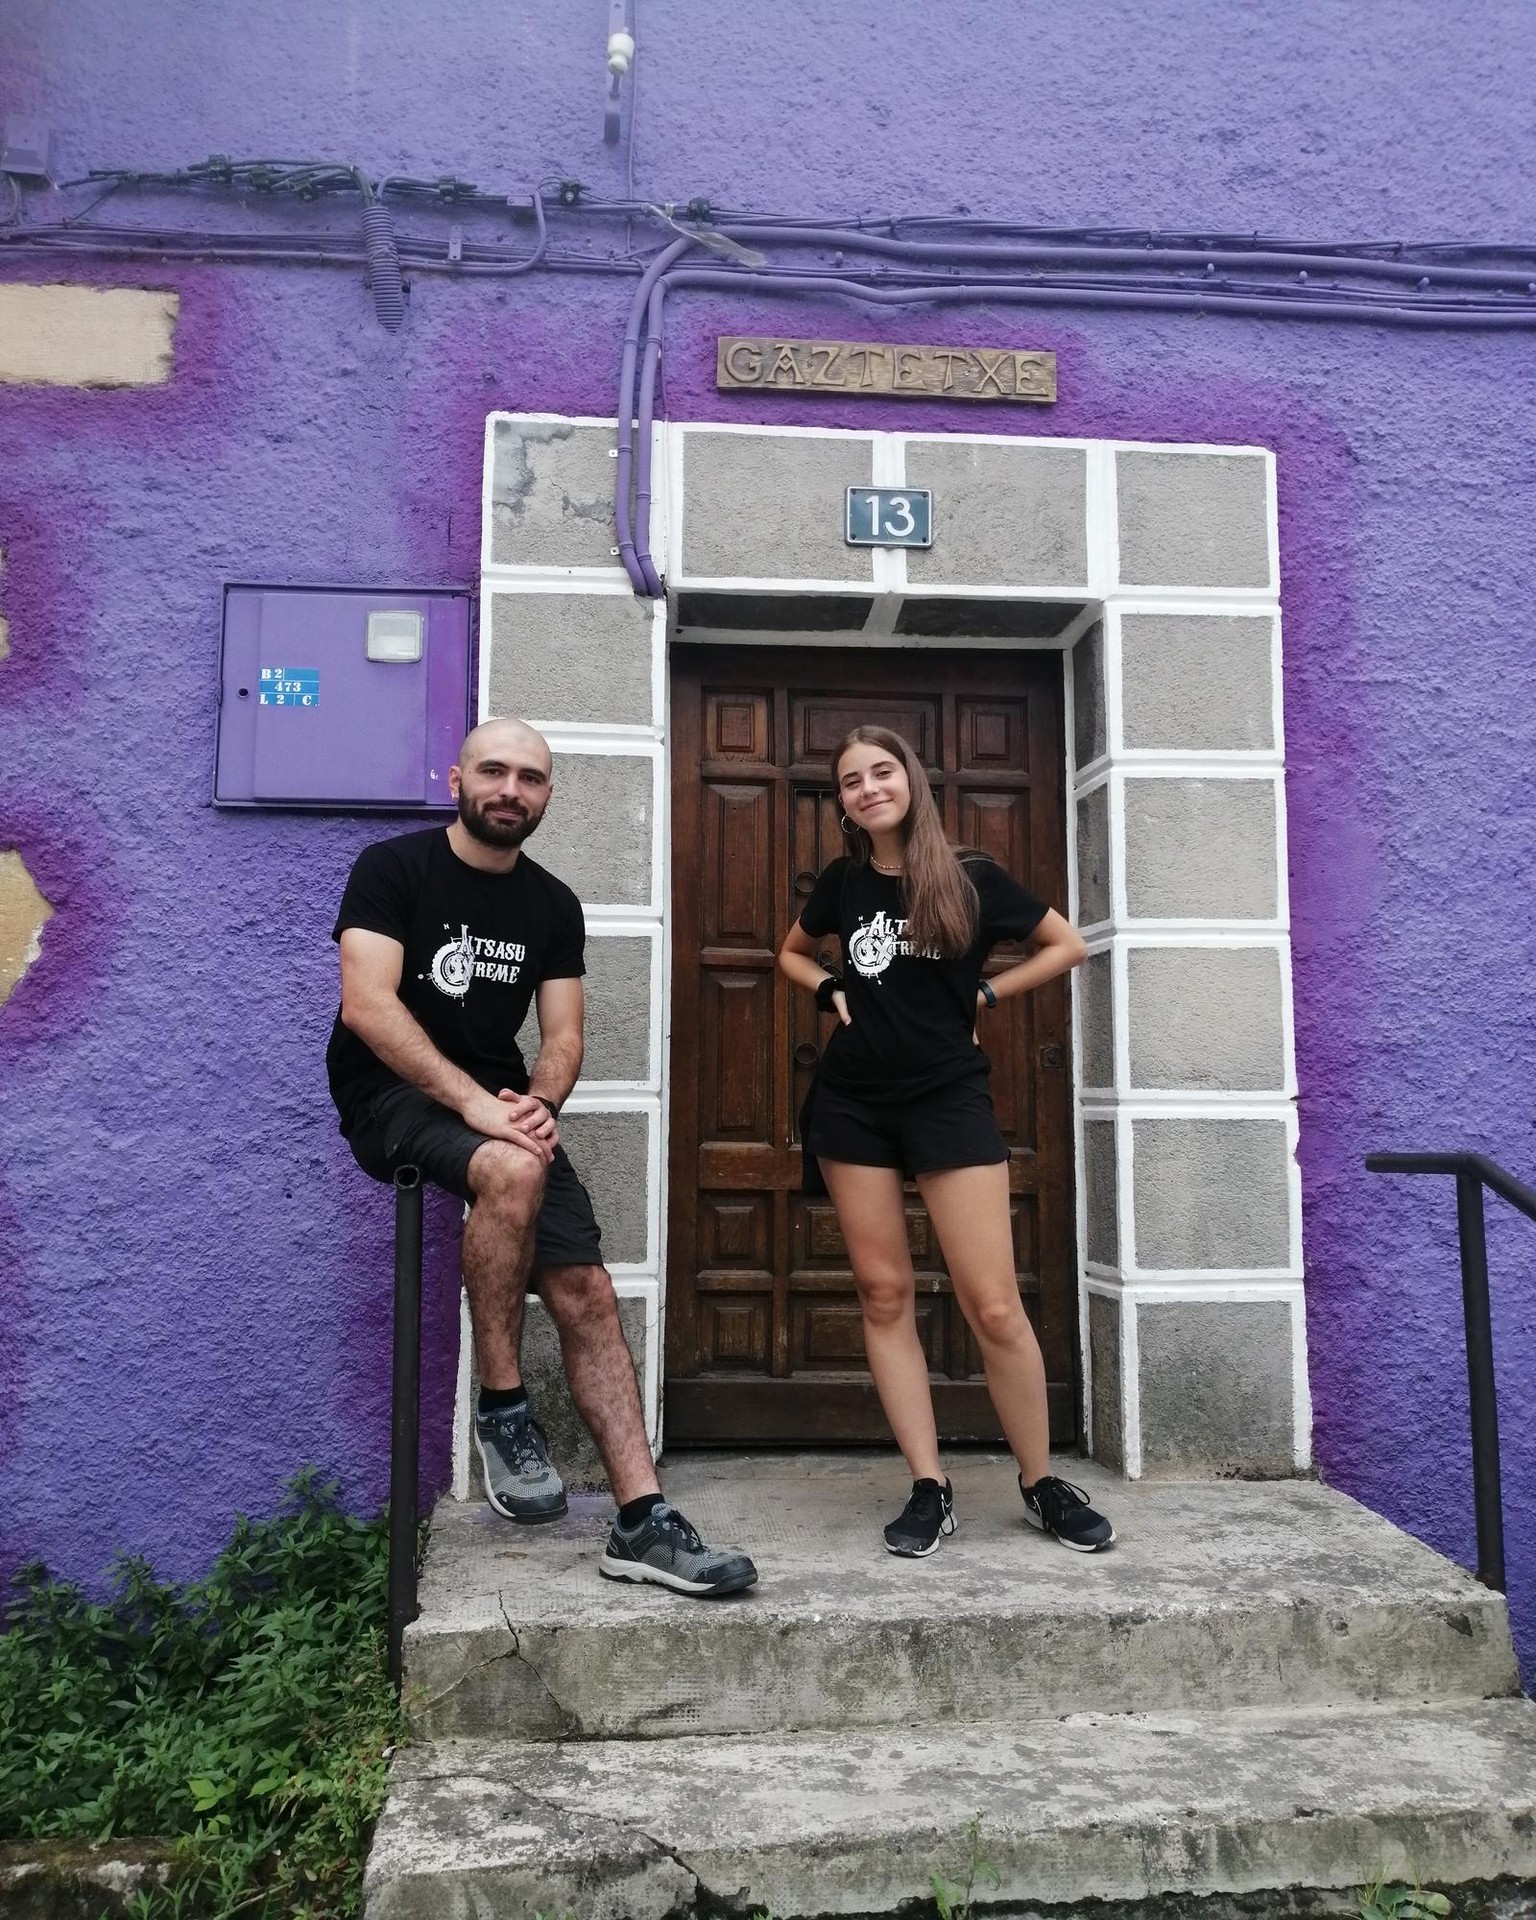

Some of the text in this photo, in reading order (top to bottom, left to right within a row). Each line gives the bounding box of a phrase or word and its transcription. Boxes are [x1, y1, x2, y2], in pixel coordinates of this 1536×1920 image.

[723, 341, 1050, 396] GAZTETXE
[865, 494, 916, 538] 13
[274, 681, 302, 693] 473
